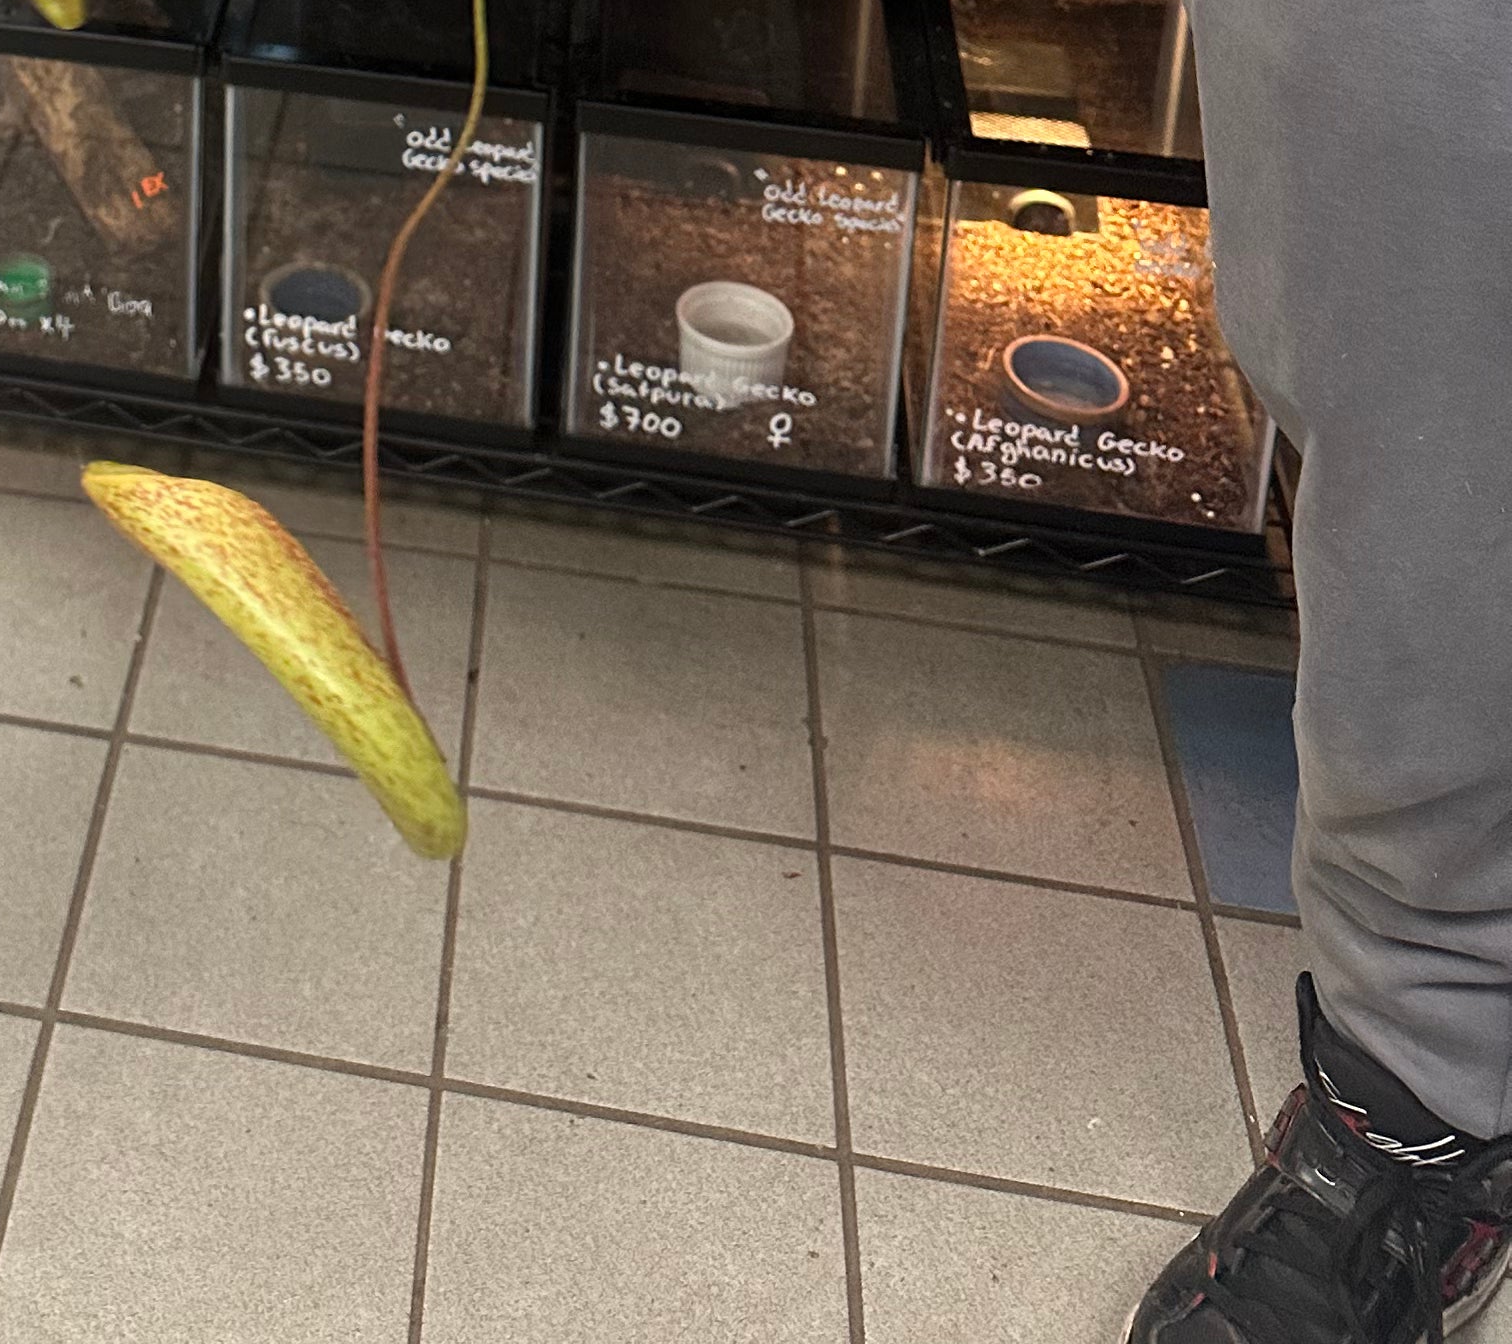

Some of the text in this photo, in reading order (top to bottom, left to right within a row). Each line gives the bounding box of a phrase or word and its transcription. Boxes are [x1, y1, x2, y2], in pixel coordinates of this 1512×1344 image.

[761, 202, 825, 226] Gecko
[818, 185, 900, 212] Leopard
[259, 303, 452, 355] Leopard ecko
[614, 353, 817, 407] Leopard Gecko
[599, 401, 683, 438] $700
[971, 408, 1186, 462] Leopard Gecko
[950, 429, 1137, 477] (Afghanicus)
